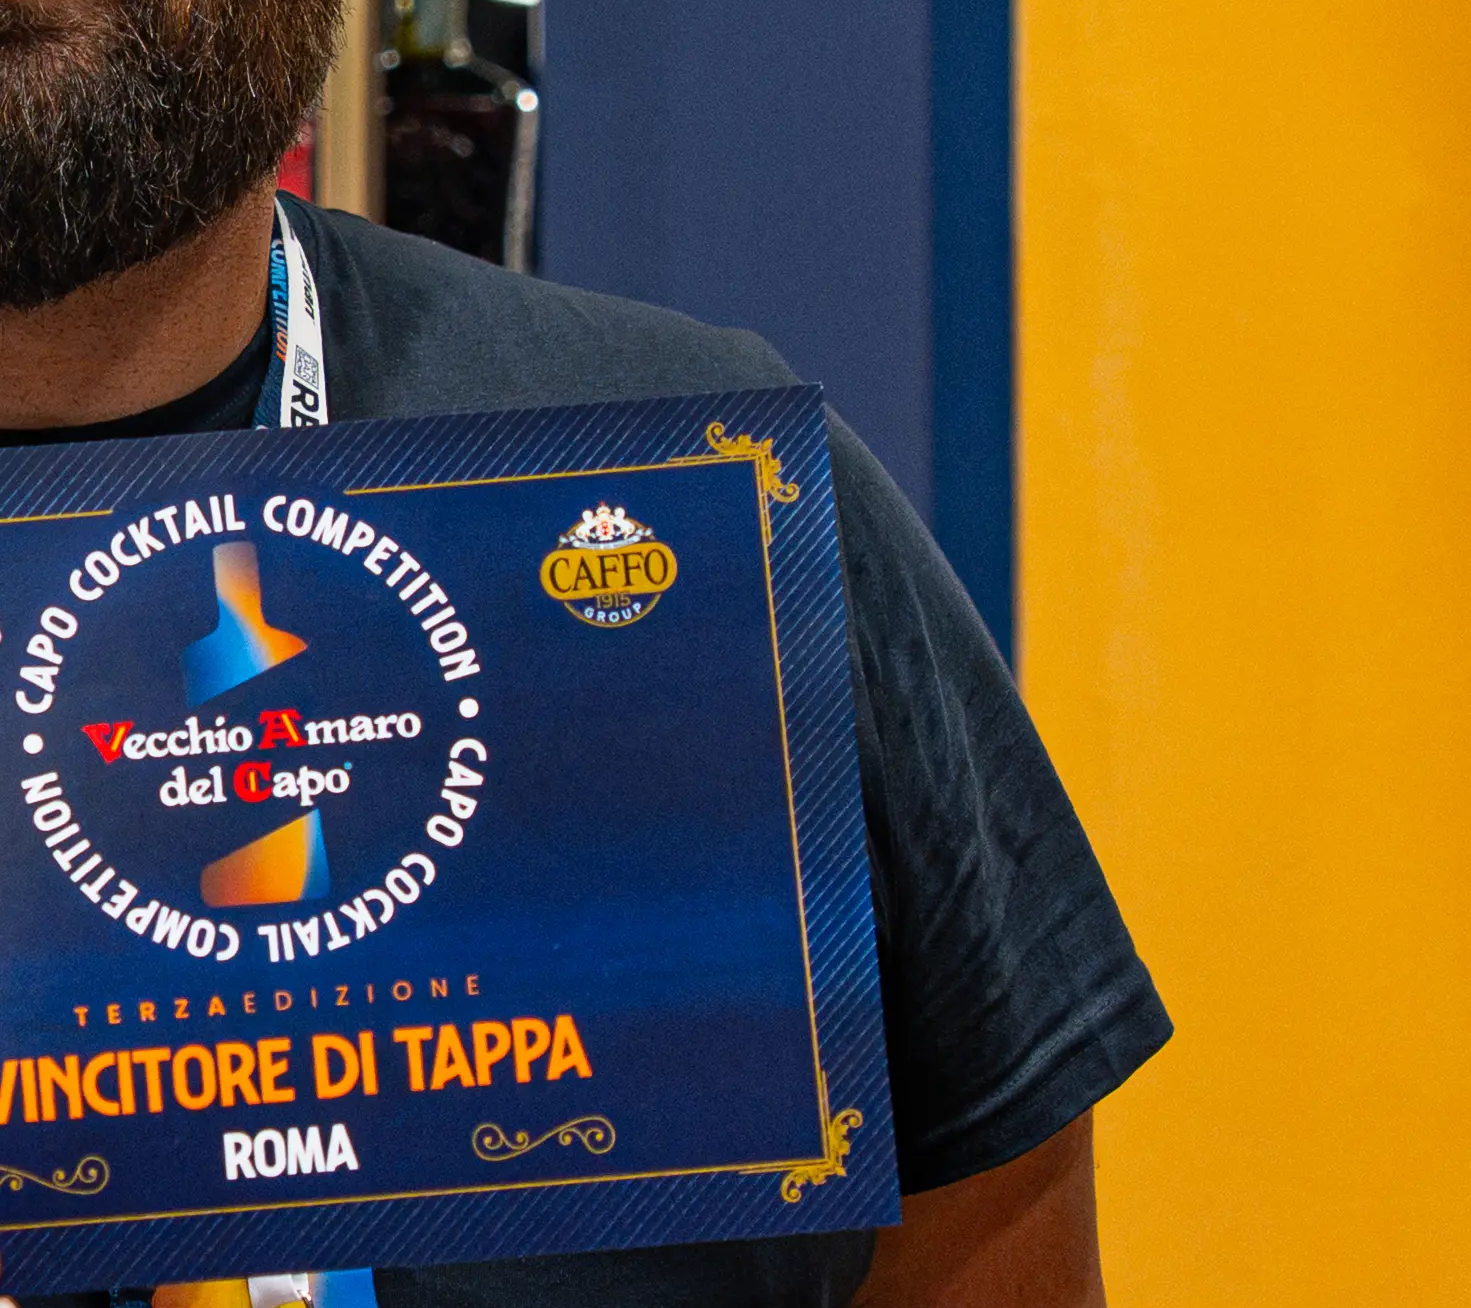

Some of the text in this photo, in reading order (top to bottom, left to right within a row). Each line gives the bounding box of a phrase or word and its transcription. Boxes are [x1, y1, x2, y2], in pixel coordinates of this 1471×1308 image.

[549, 549, 668, 593] CAFFO
[15, 494, 481, 714] CAPO COCKTAIL COMPETITION
[584, 602, 642, 623] GROUP
[595, 593, 631, 609] 1915
[80, 708, 422, 764] Vecchio Amaro
[159, 761, 351, 807] del Capo
[20, 738, 488, 963] CAPO COCKTAIL COMPETITION
[311, 1029, 378, 1101] DI
[393, 1014, 593, 1093] TAPPA
[221, 1122, 360, 1182] ROMA
